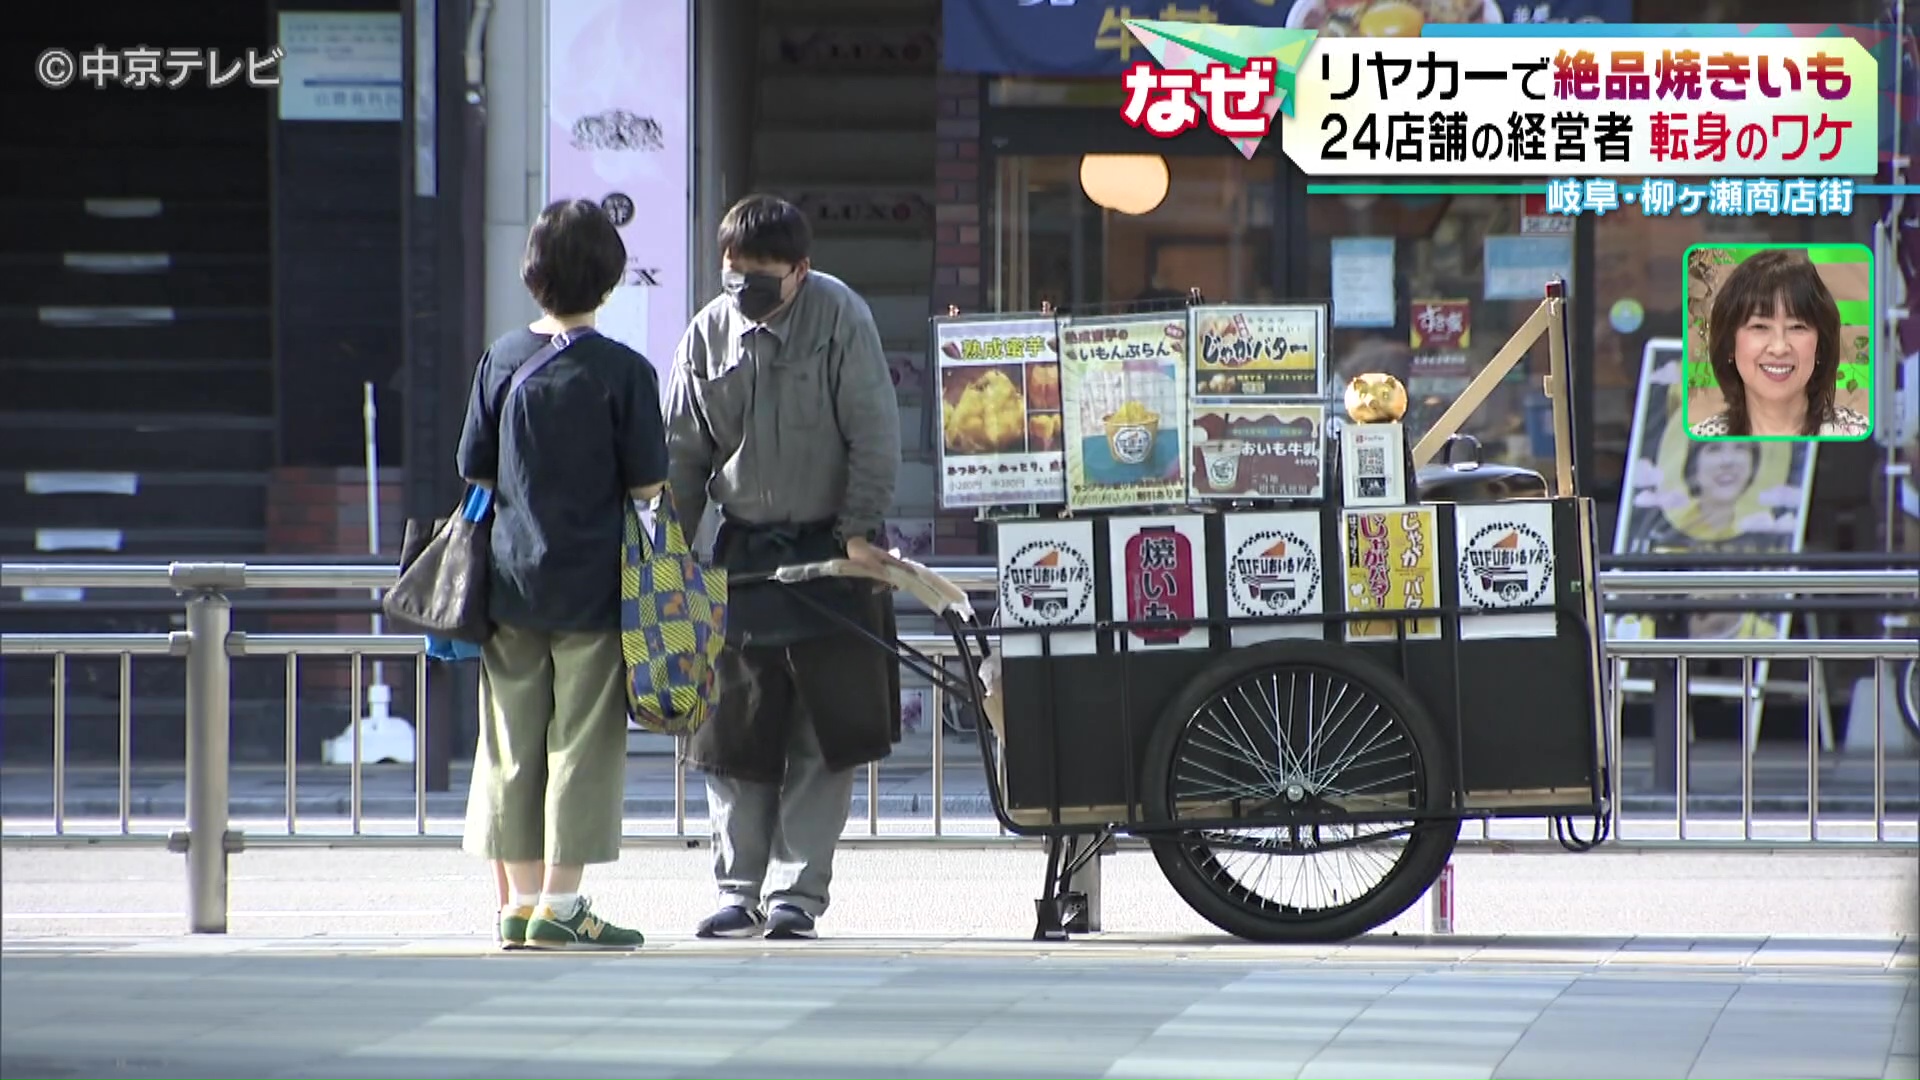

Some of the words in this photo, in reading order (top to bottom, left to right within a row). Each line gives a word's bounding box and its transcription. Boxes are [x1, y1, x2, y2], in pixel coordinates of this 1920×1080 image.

[961, 336, 1046, 361] 熟成蜜芋
[1079, 343, 1171, 361] いもんぶらん
[1202, 334, 1309, 365] じゃがバター
[1241, 440, 1318, 457] おいも牛乳
